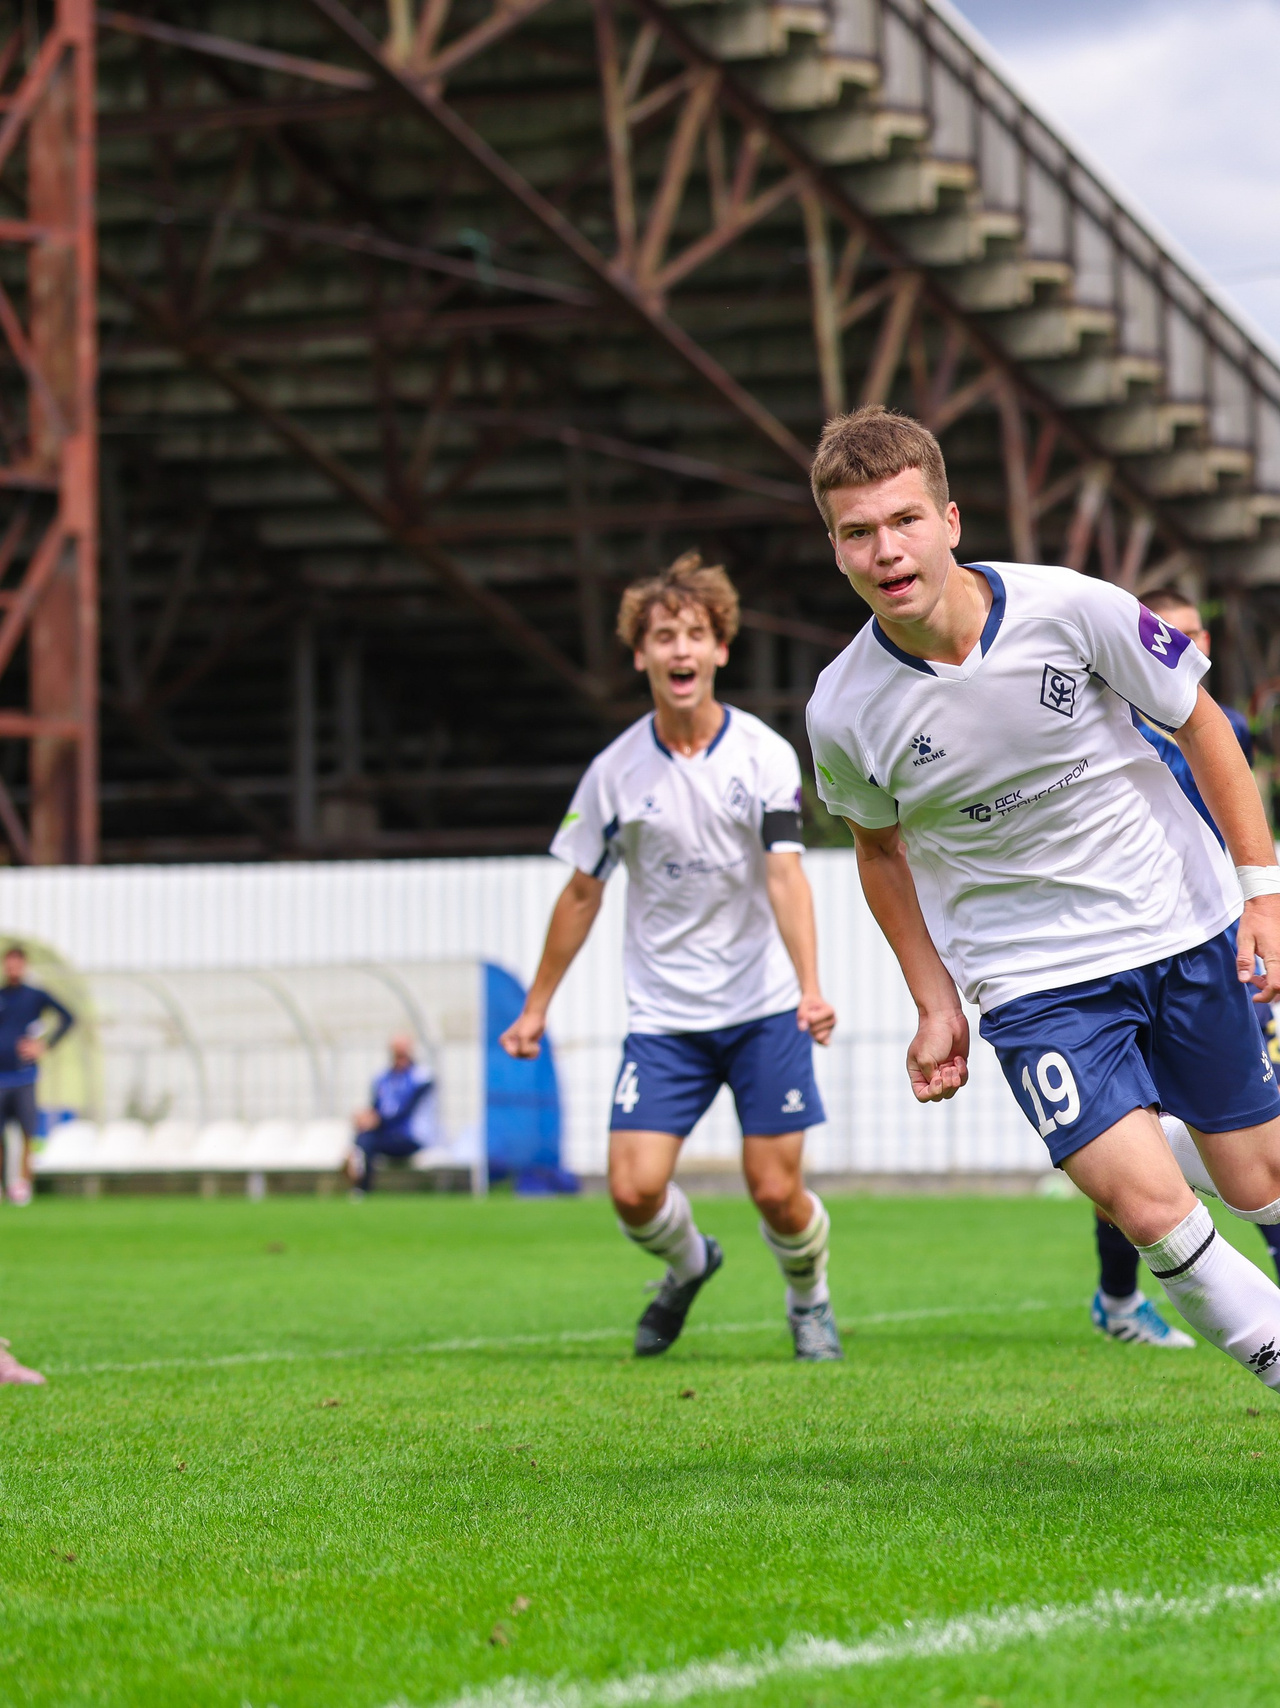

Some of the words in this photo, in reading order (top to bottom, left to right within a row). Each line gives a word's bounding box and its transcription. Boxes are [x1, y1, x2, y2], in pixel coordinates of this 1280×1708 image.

[912, 749, 947, 767] KELME
[995, 790, 1023, 810] ДСК
[614, 1061, 641, 1114] 4
[1021, 1051, 1081, 1138] 19
